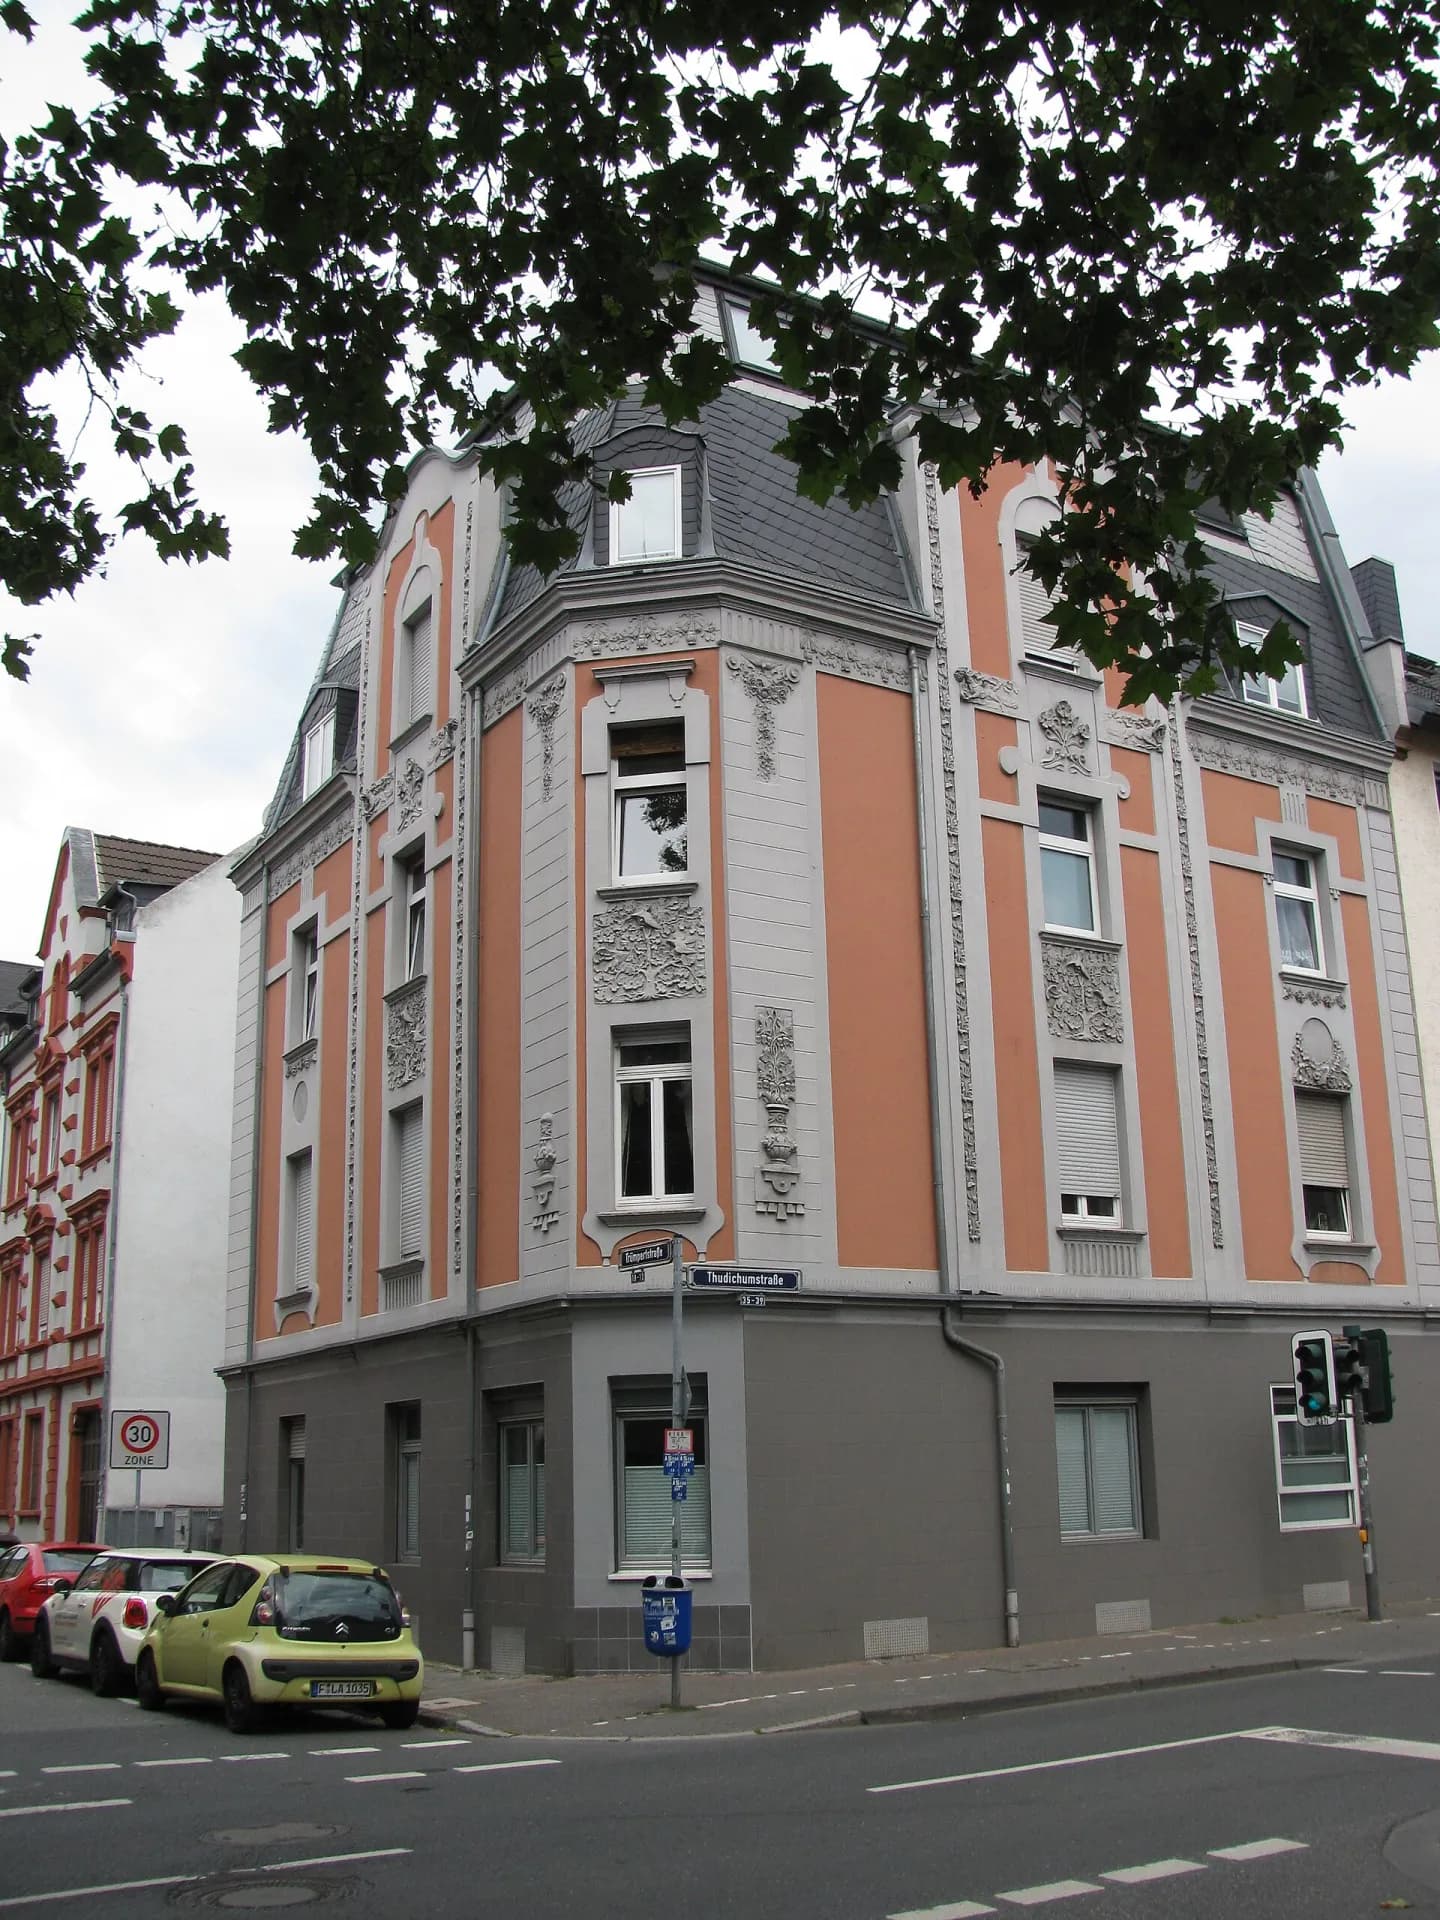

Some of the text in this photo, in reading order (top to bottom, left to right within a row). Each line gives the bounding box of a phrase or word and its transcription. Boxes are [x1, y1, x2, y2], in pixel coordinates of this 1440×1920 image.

[707, 1271, 784, 1286] Thudichumstraße
[129, 1425, 151, 1443] 30
[124, 1455, 154, 1465] ZONE
[345, 1682, 370, 1694] 1035
